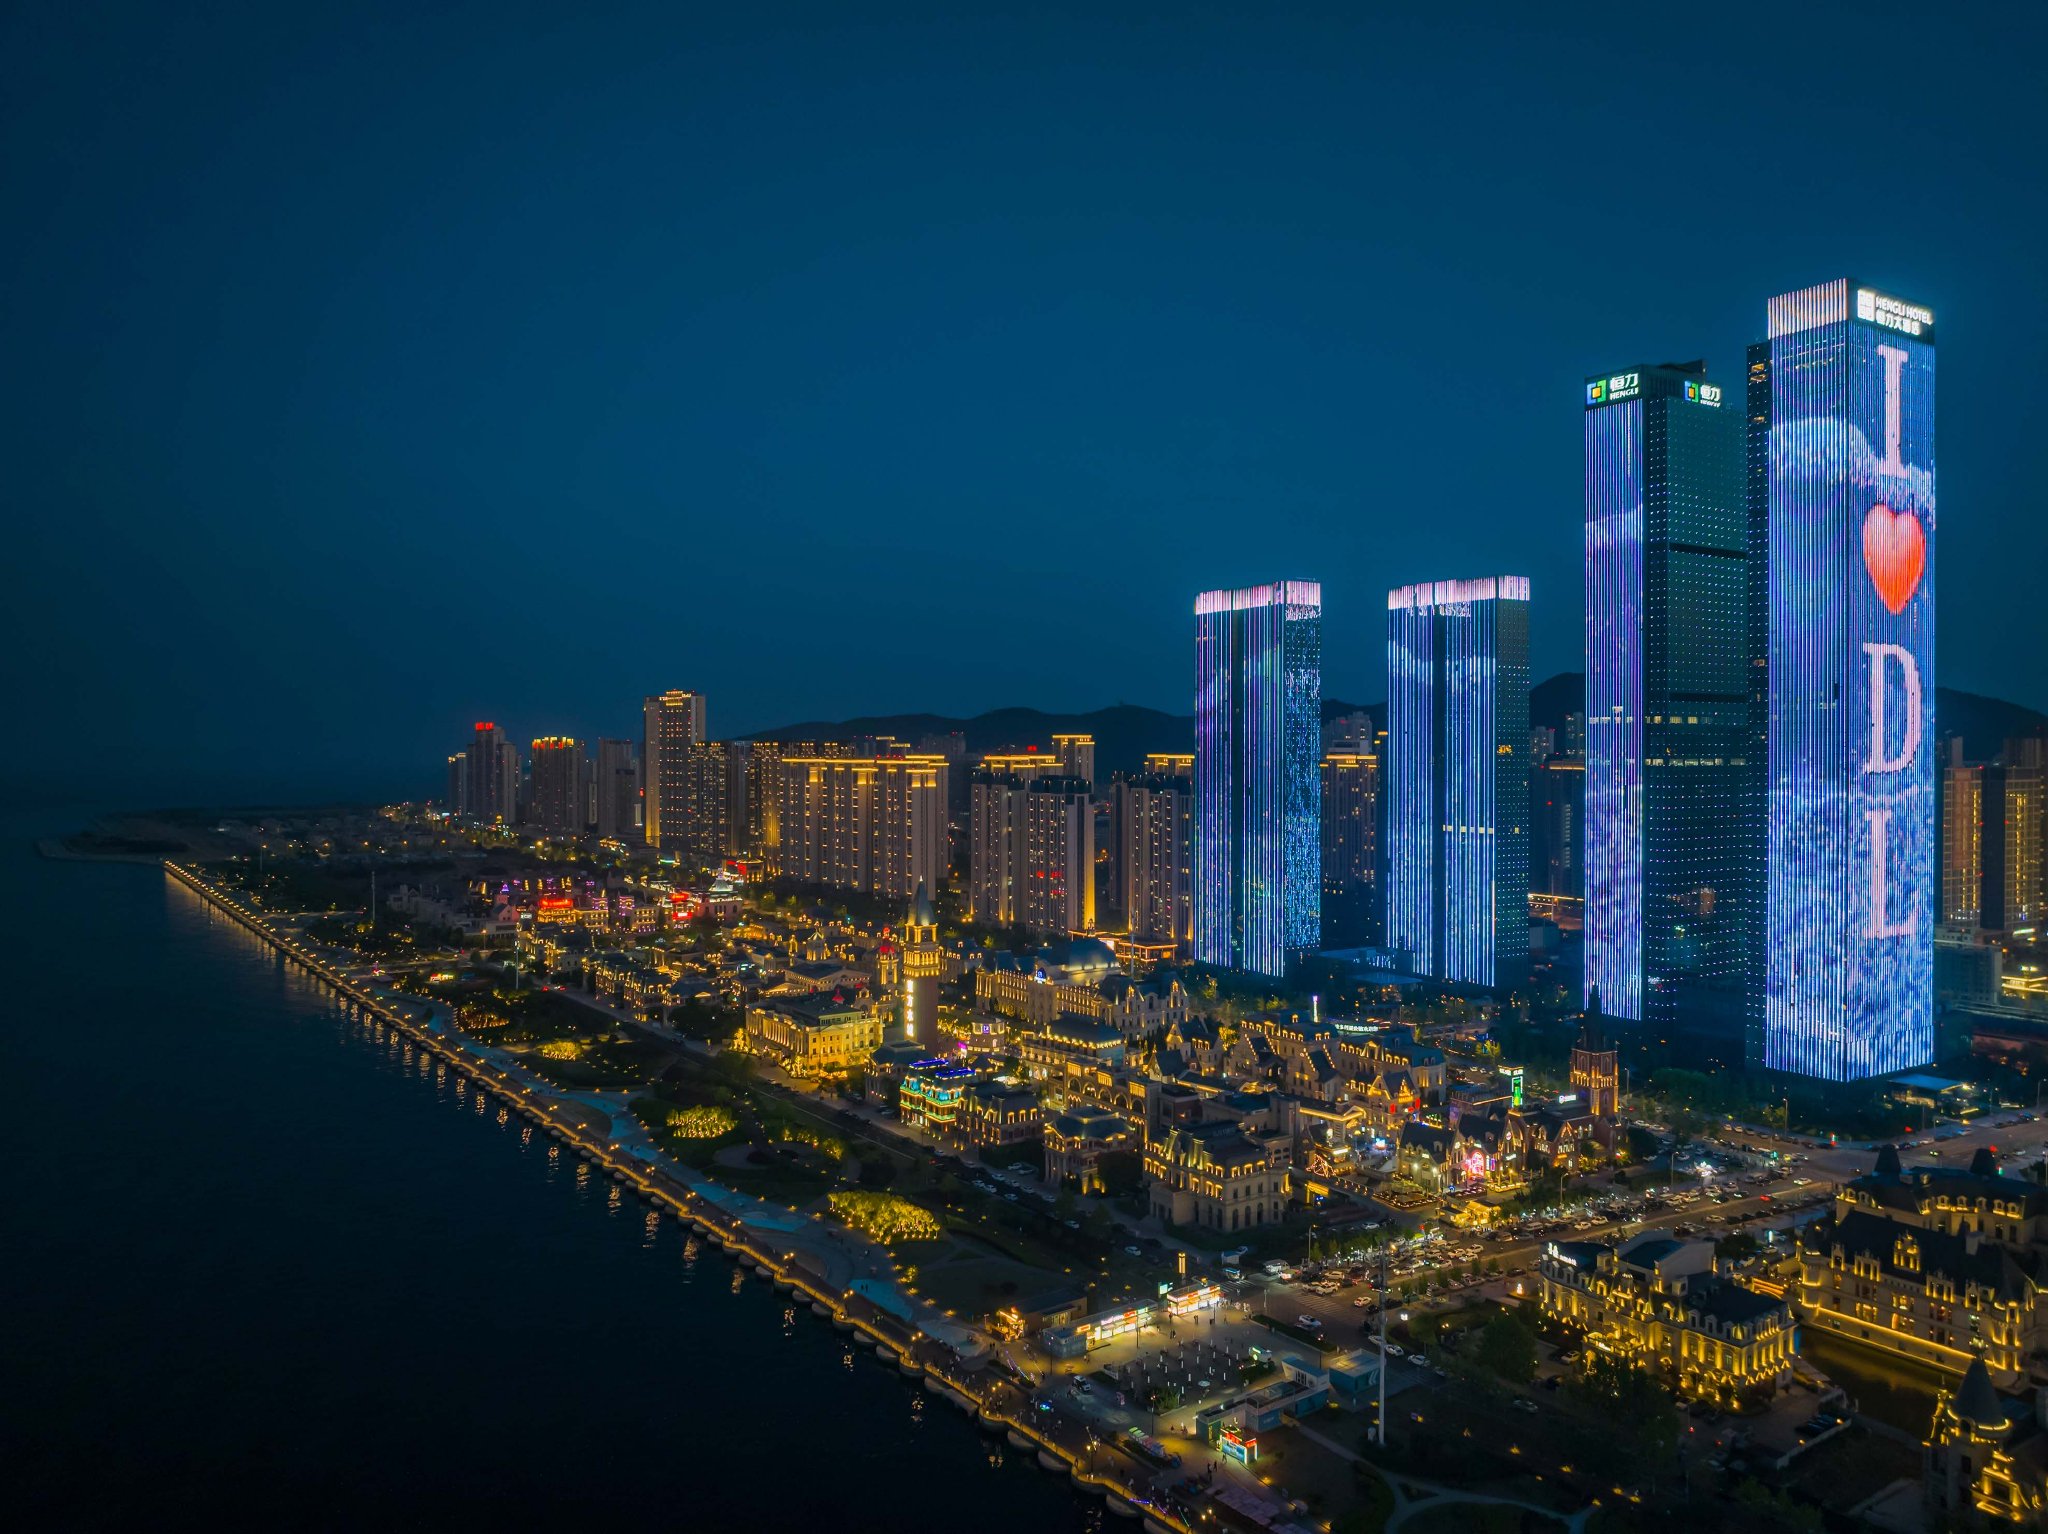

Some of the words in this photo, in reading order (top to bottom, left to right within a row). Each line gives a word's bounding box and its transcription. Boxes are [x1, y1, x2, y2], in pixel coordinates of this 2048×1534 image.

[1875, 295, 1906, 317] HENGLI
[1906, 304, 1933, 325] HOTEL
[1609, 373, 1639, 391] 恒力
[1609, 387, 1639, 400] HENGLI
[1877, 344, 1908, 478] I
